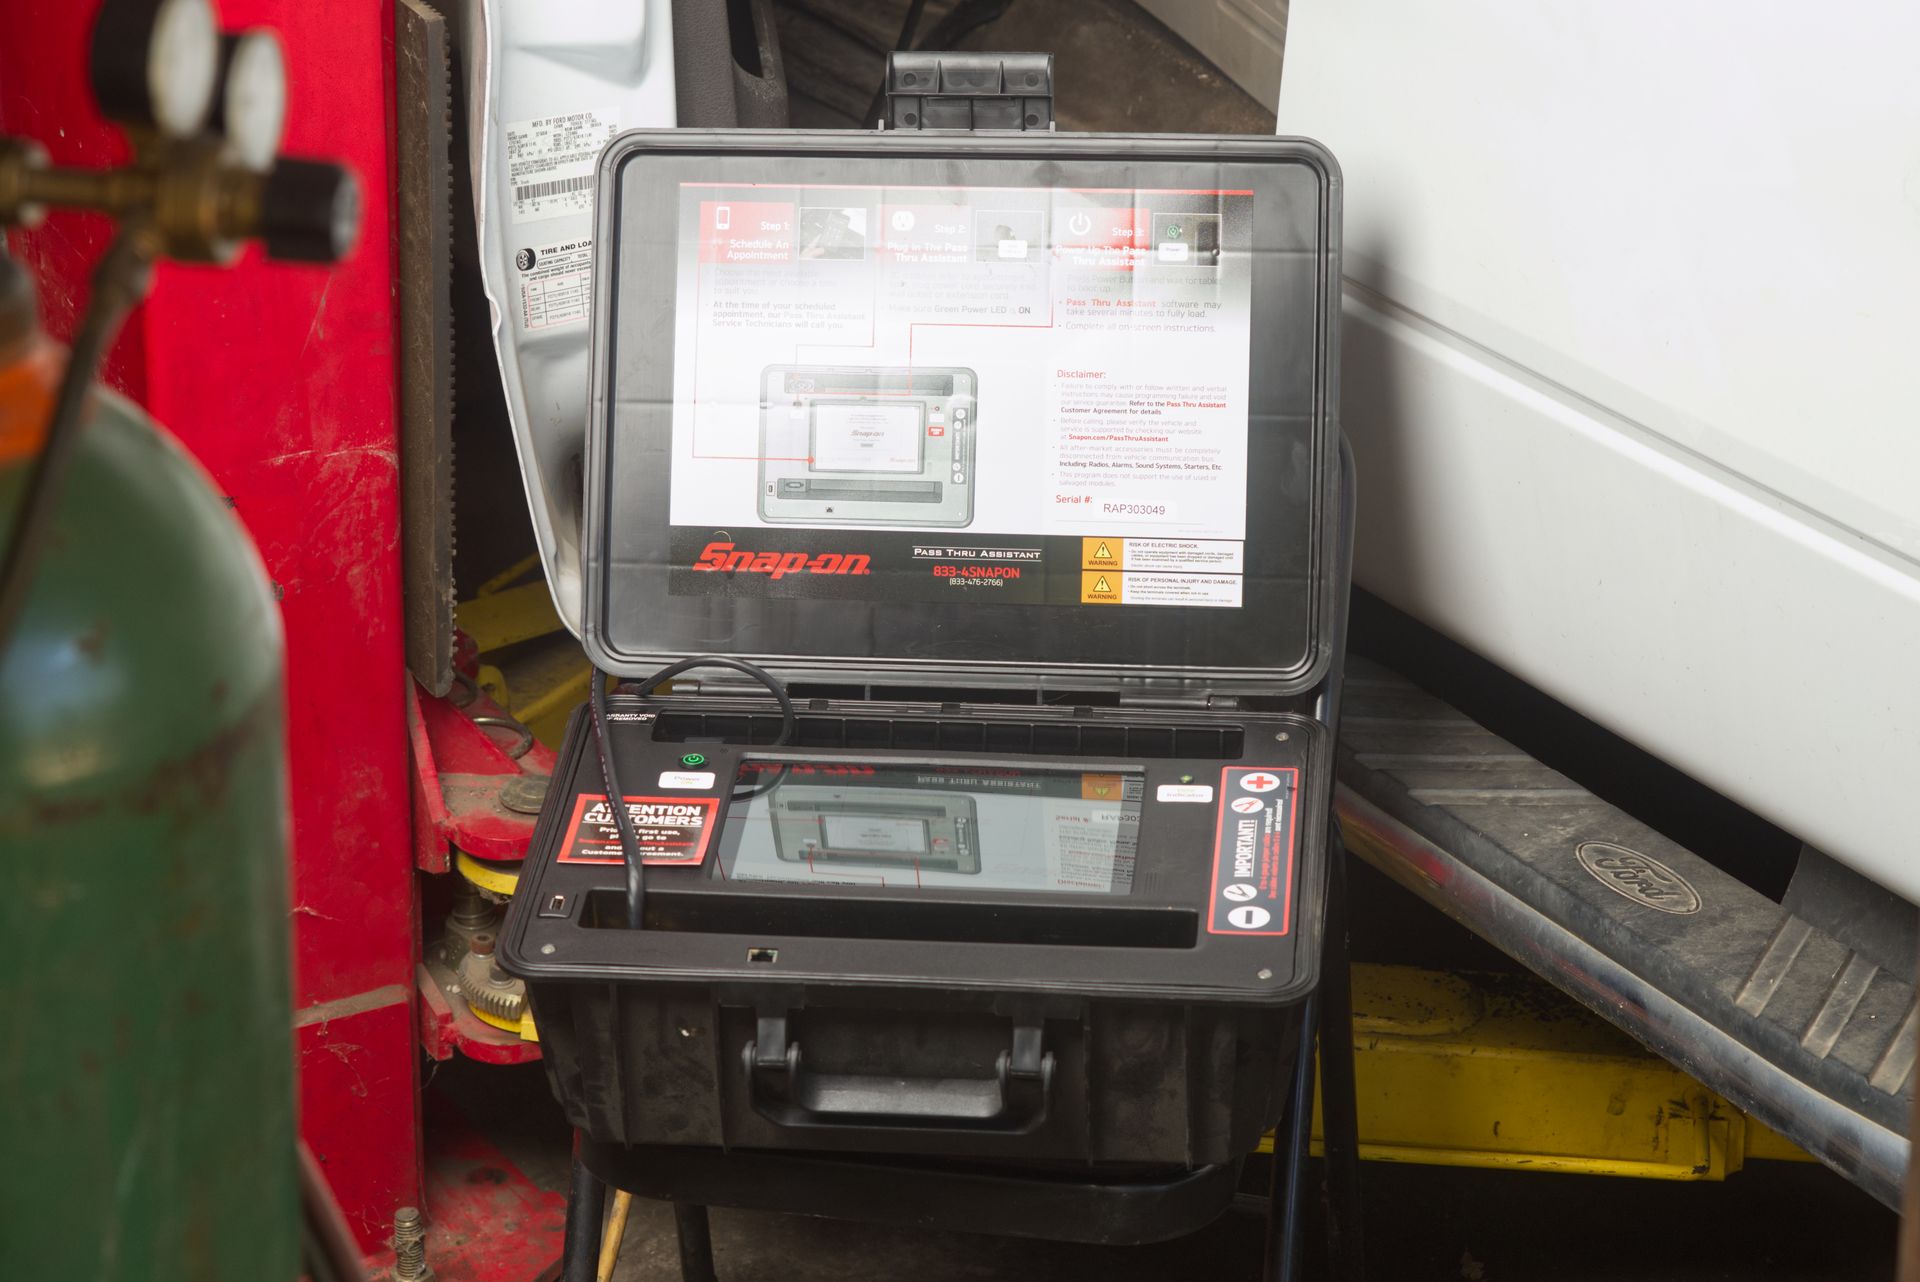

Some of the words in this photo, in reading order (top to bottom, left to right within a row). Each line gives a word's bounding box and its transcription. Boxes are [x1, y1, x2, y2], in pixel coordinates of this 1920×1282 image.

[566, 114, 584, 122] MOTOR
[760, 221, 781, 231] Step
[935, 224, 955, 234] Step
[1112, 228, 1133, 238] Step
[730, 239, 772, 249] Schedule
[776, 240, 789, 249] An
[541, 247, 558, 256] TIRE
[560, 244, 576, 252] AND
[727, 251, 789, 260] Appointment
[896, 253, 919, 262] Thru
[921, 254, 968, 263] Assistant
[1072, 257, 1095, 266] Thru
[1099, 257, 1145, 266] Assistant
[713, 301, 723, 309] At
[725, 301, 739, 309] the
[742, 301, 759, 309] time
[762, 301, 770, 309] of
[773, 303, 791, 311] your
[794, 302, 837, 311] scheduled
[1066, 299, 1086, 307] Pass
[1092, 299, 1111, 307] Thru
[1116, 299, 1156, 308] Assistant
[1161, 300, 1199, 309] software
[934, 305, 959, 313] Green
[961, 305, 988, 313] Power
[991, 306, 1007, 314] LED
[1018, 306, 1031, 314] ON
[1066, 308, 1084, 316] take
[1087, 308, 1117, 316] several
[1120, 309, 1154, 317] minutes
[1167, 310, 1185, 319] fully
[826, 312, 866, 321] Assistant
[712, 319, 742, 328] Service
[745, 320, 792, 328] Technicians
[794, 320, 809, 329] will
[811, 321, 825, 329] call
[1065, 322, 1104, 331] Complete
[1056, 369, 1107, 379] Disclaimer:
[1093, 407, 1127, 415] Agreement
[1068, 434, 1169, 442] Snapon.com/PassThruAssistant
[1156, 462, 1182, 470] Systems,
[1055, 494, 1082, 504] Serial
[1084, 496, 1093, 504] #:
[1103, 503, 1166, 516] RAP303049
[693, 542, 870, 580] Snap-on
[933, 566, 1020, 579] 833-4SNAPON
[949, 577, 1003, 587] (833-476-2766)
[1087, 593, 1117, 601] WARNING
[591, 803, 701, 816] ATENTION
[584, 812, 703, 825] CUTOMERS
[1234, 819, 1256, 878] IMPORTANT!
[1595, 856, 1681, 900] Ford
